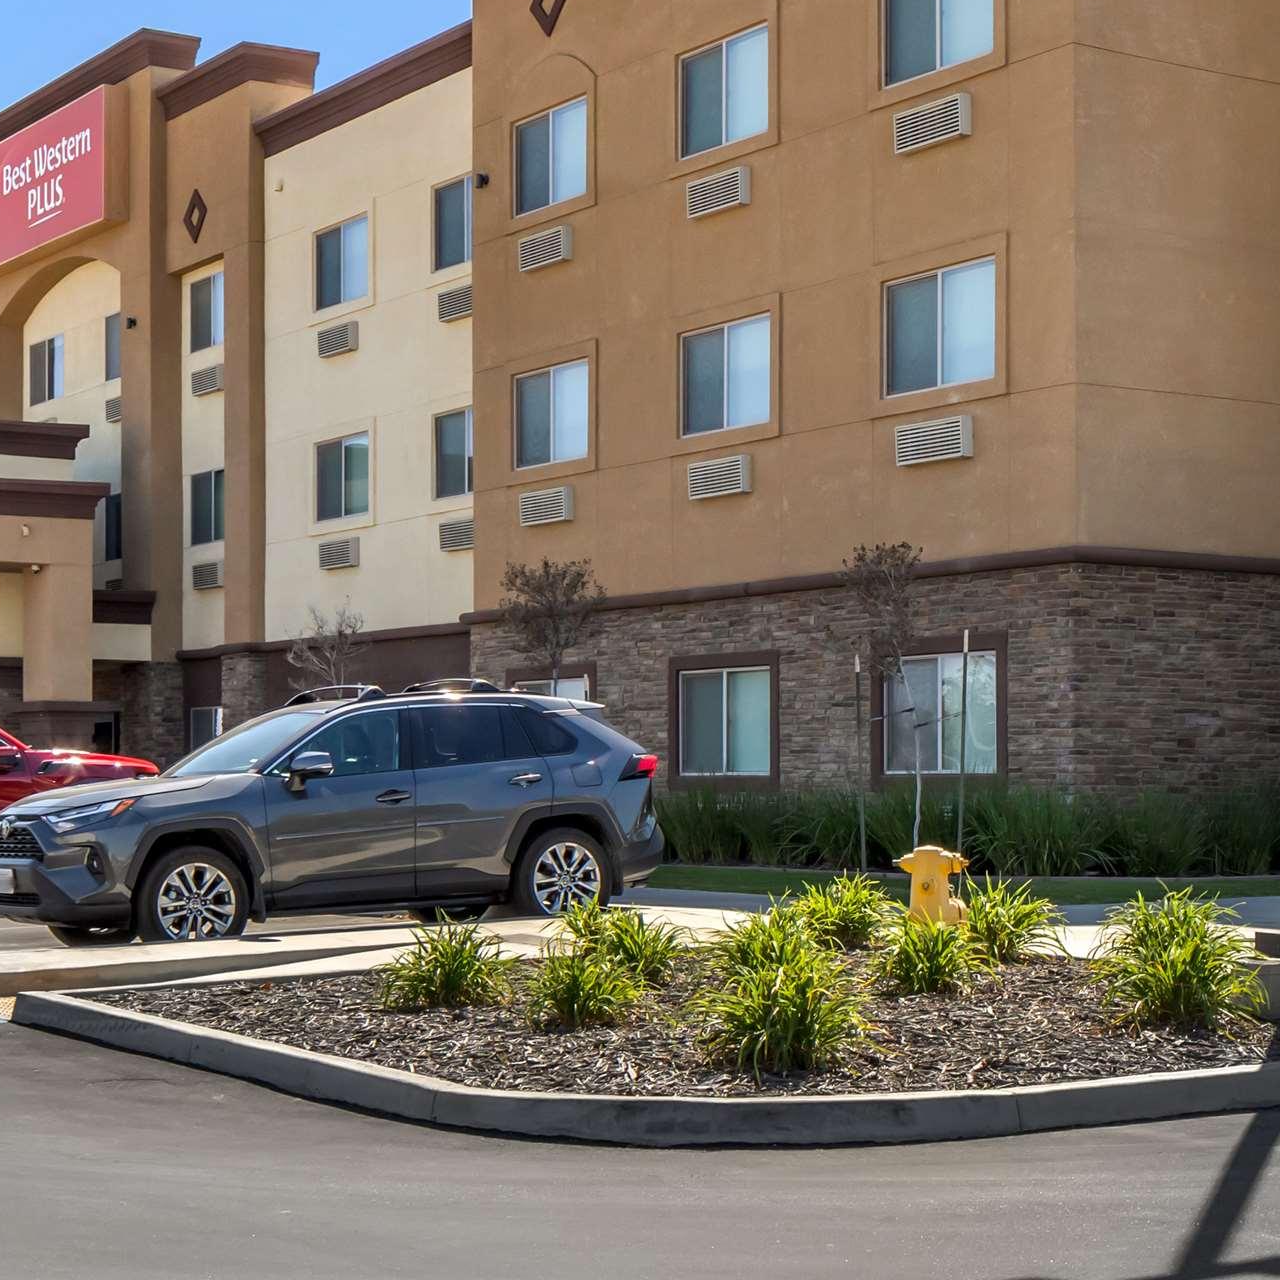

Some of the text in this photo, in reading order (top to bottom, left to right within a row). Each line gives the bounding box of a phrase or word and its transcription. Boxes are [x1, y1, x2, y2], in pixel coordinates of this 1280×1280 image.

[2, 127, 92, 196] Best Western
[27, 174, 64, 220] PLUS
